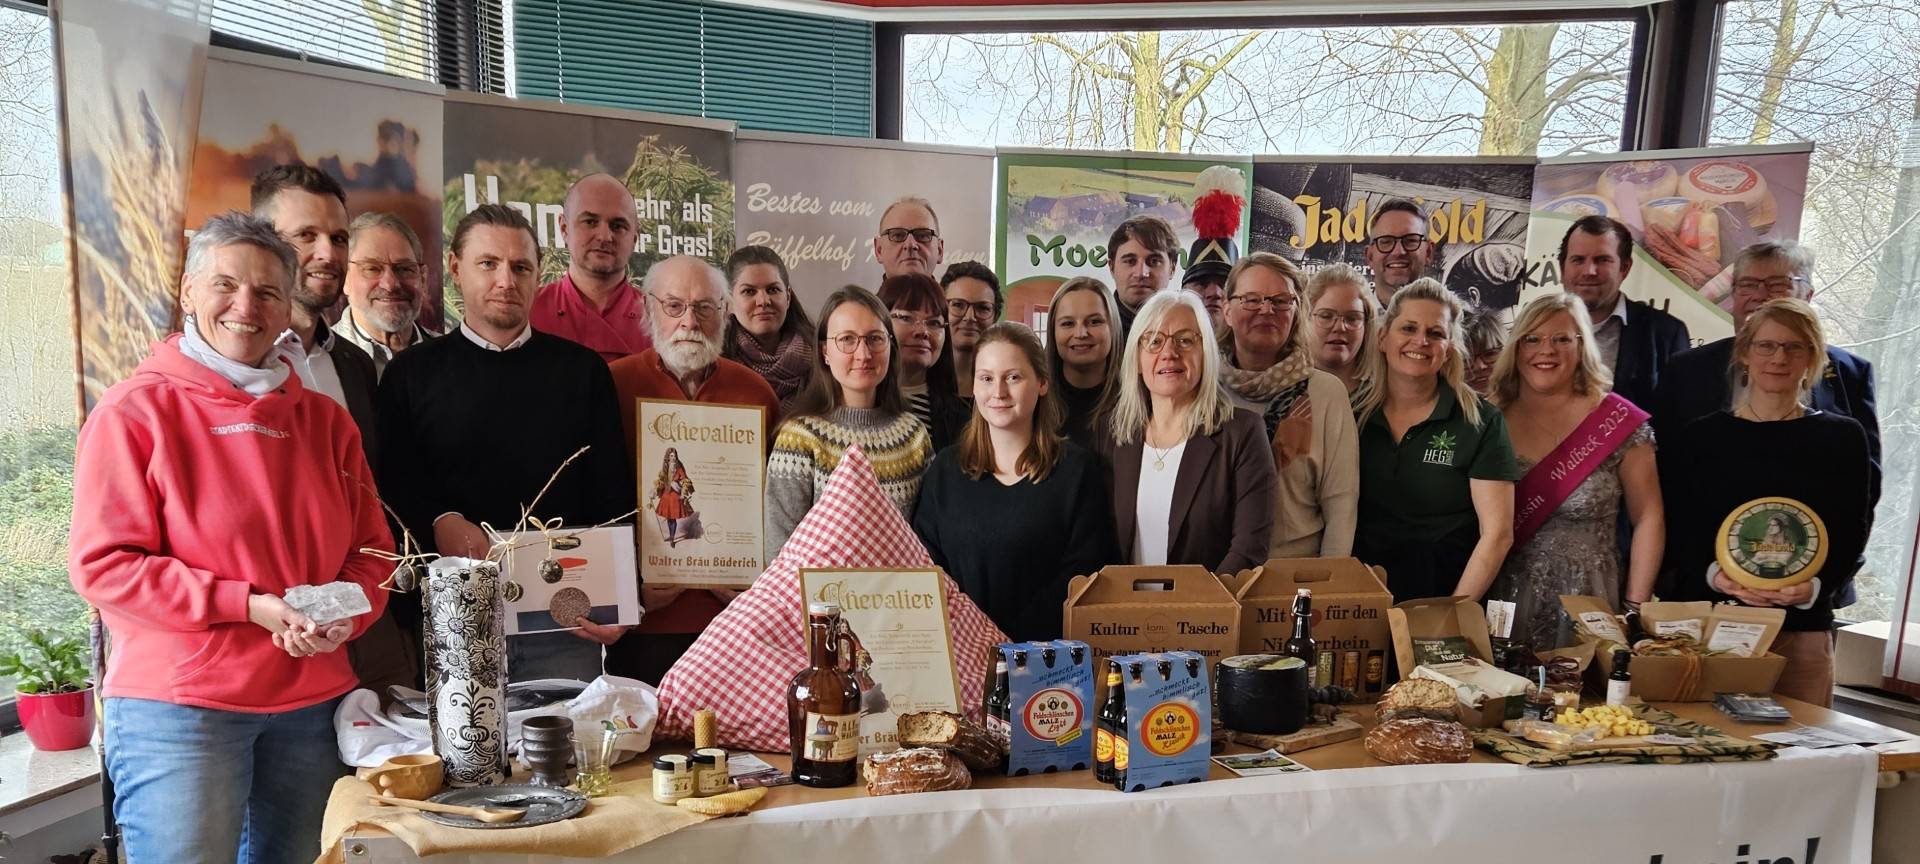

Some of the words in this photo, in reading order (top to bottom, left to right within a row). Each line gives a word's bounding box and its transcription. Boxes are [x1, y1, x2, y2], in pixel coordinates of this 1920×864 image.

[634, 189, 671, 220] ehr
[682, 193, 713, 223] als
[746, 183, 822, 215] Bestes
[829, 200, 875, 216] vom
[1290, 195, 1486, 250] Jadold
[657, 225, 713, 257] Gras!
[648, 411, 755, 445] Chevalier
[1551, 434, 1605, 481] Walbeck
[1599, 402, 1630, 437] 2025
[1423, 448, 1447, 463] HEG
[648, 555, 682, 567] Walter
[686, 555, 710, 567] Bräu
[713, 556, 757, 568] Büderich
[813, 579, 934, 613] Chevalier
[1256, 608, 1286, 624] Mit
[1325, 605, 1349, 620] für
[1352, 604, 1378, 620] den
[1089, 622, 1140, 636] Kultur
[1176, 621, 1229, 635] Tasche
[1262, 636, 1369, 652] Nirrhein
[1440, 653, 1465, 662] Natur
[1039, 718, 1060, 726] MALZ
[1155, 732, 1177, 741] MALZ
